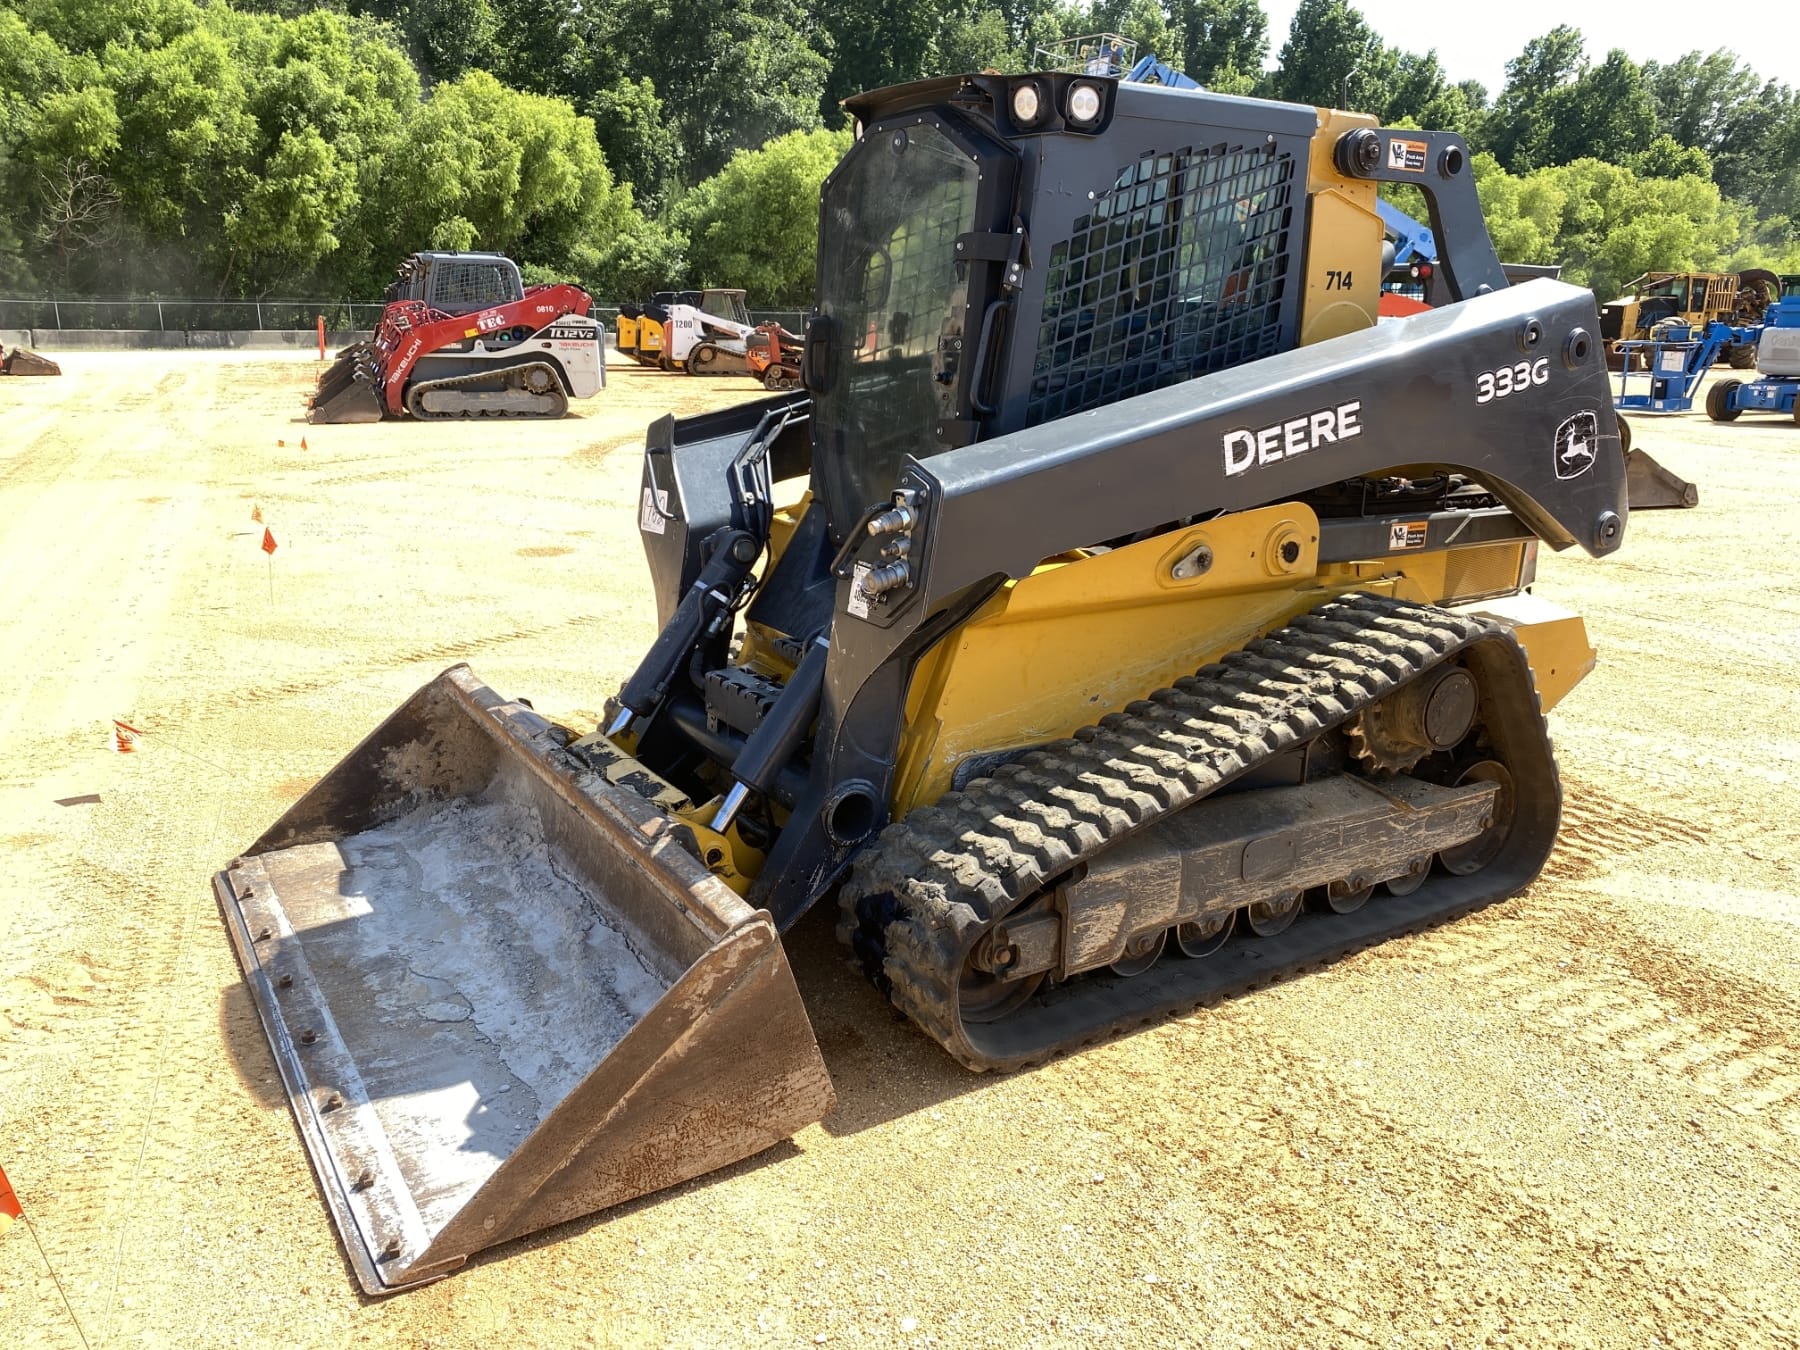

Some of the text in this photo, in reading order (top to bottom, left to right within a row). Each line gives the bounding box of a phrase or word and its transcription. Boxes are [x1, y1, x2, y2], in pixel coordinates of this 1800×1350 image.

[1326, 271, 1352, 290] 714
[476, 315, 506, 331] TEC
[1476, 356, 1549, 404] 333G
[1224, 401, 1361, 476] DEERE
